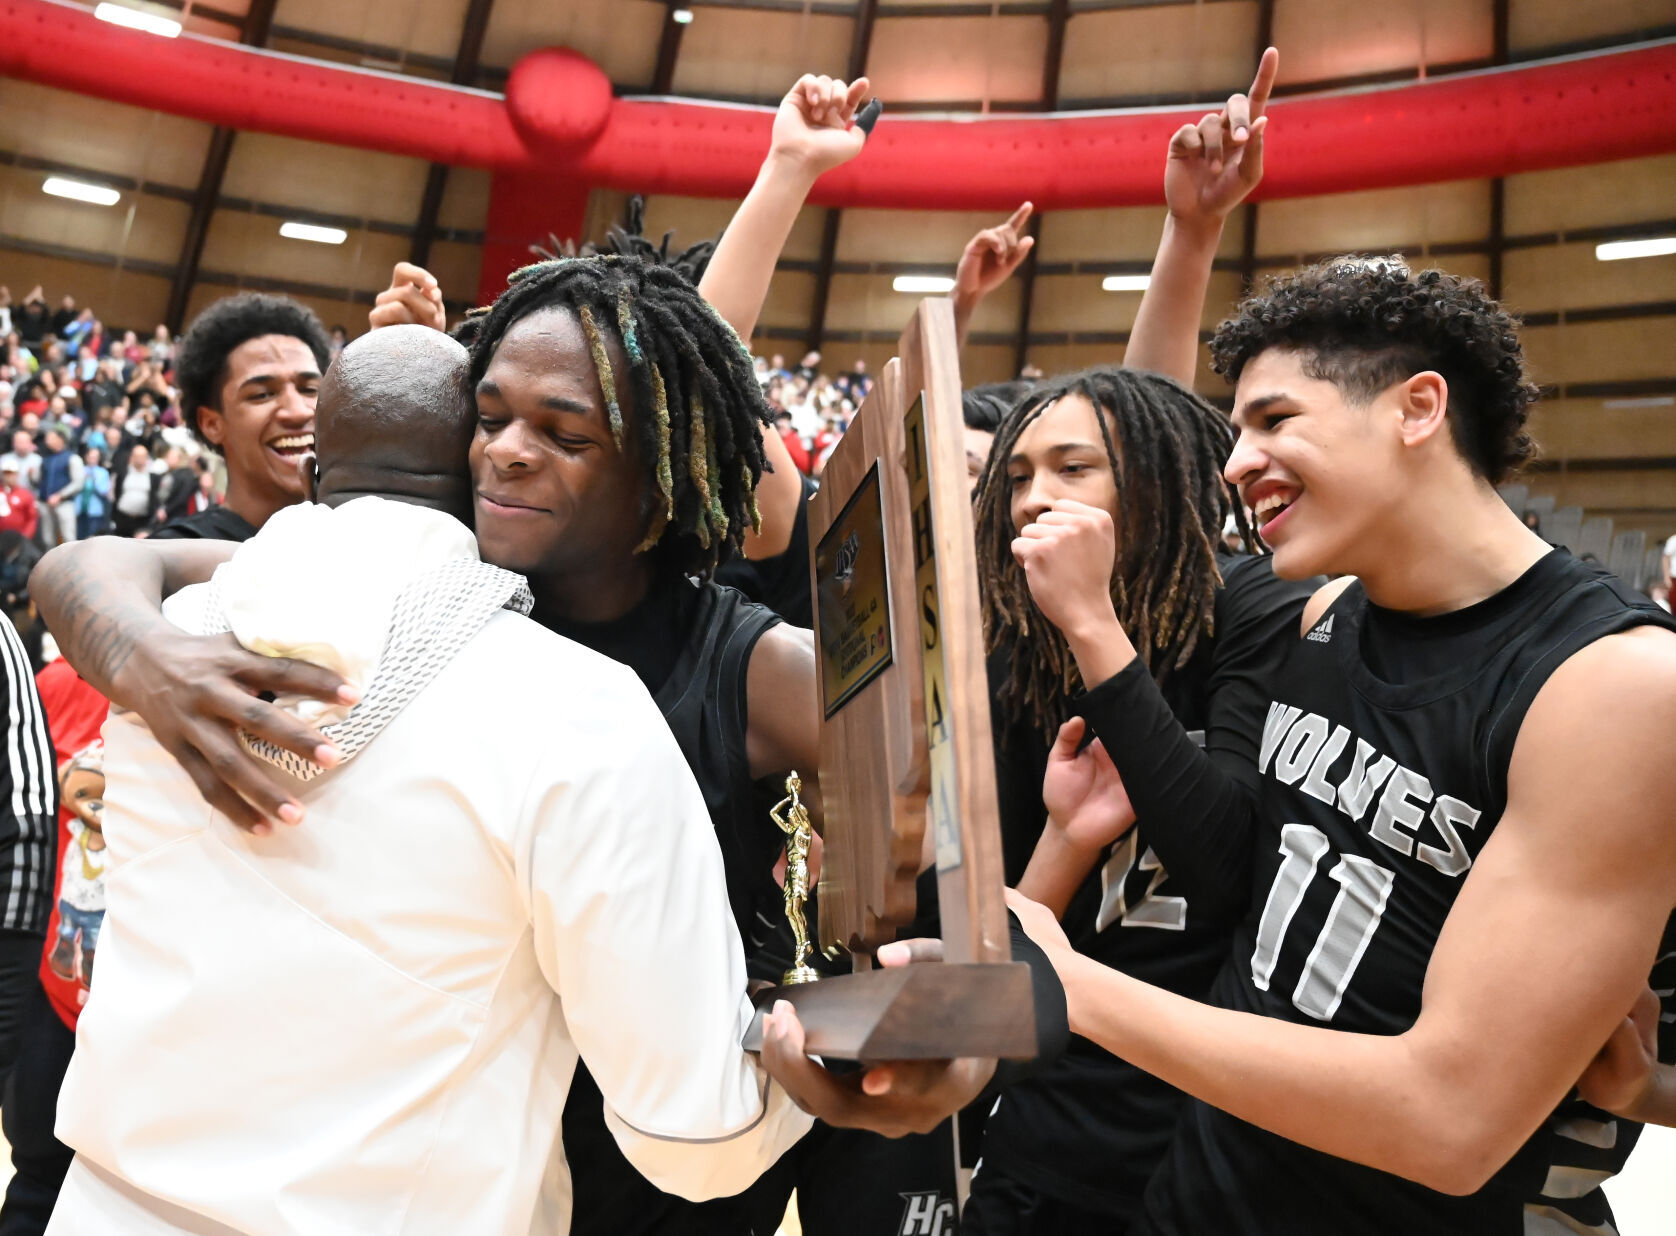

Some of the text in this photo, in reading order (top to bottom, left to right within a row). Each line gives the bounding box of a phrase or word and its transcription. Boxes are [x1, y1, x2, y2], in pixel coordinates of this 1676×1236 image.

[909, 423, 958, 849] IHSAA
[1306, 631, 1332, 643] adidas
[1259, 701, 1481, 877] WOLVES
[1251, 823, 1396, 1021] 11
